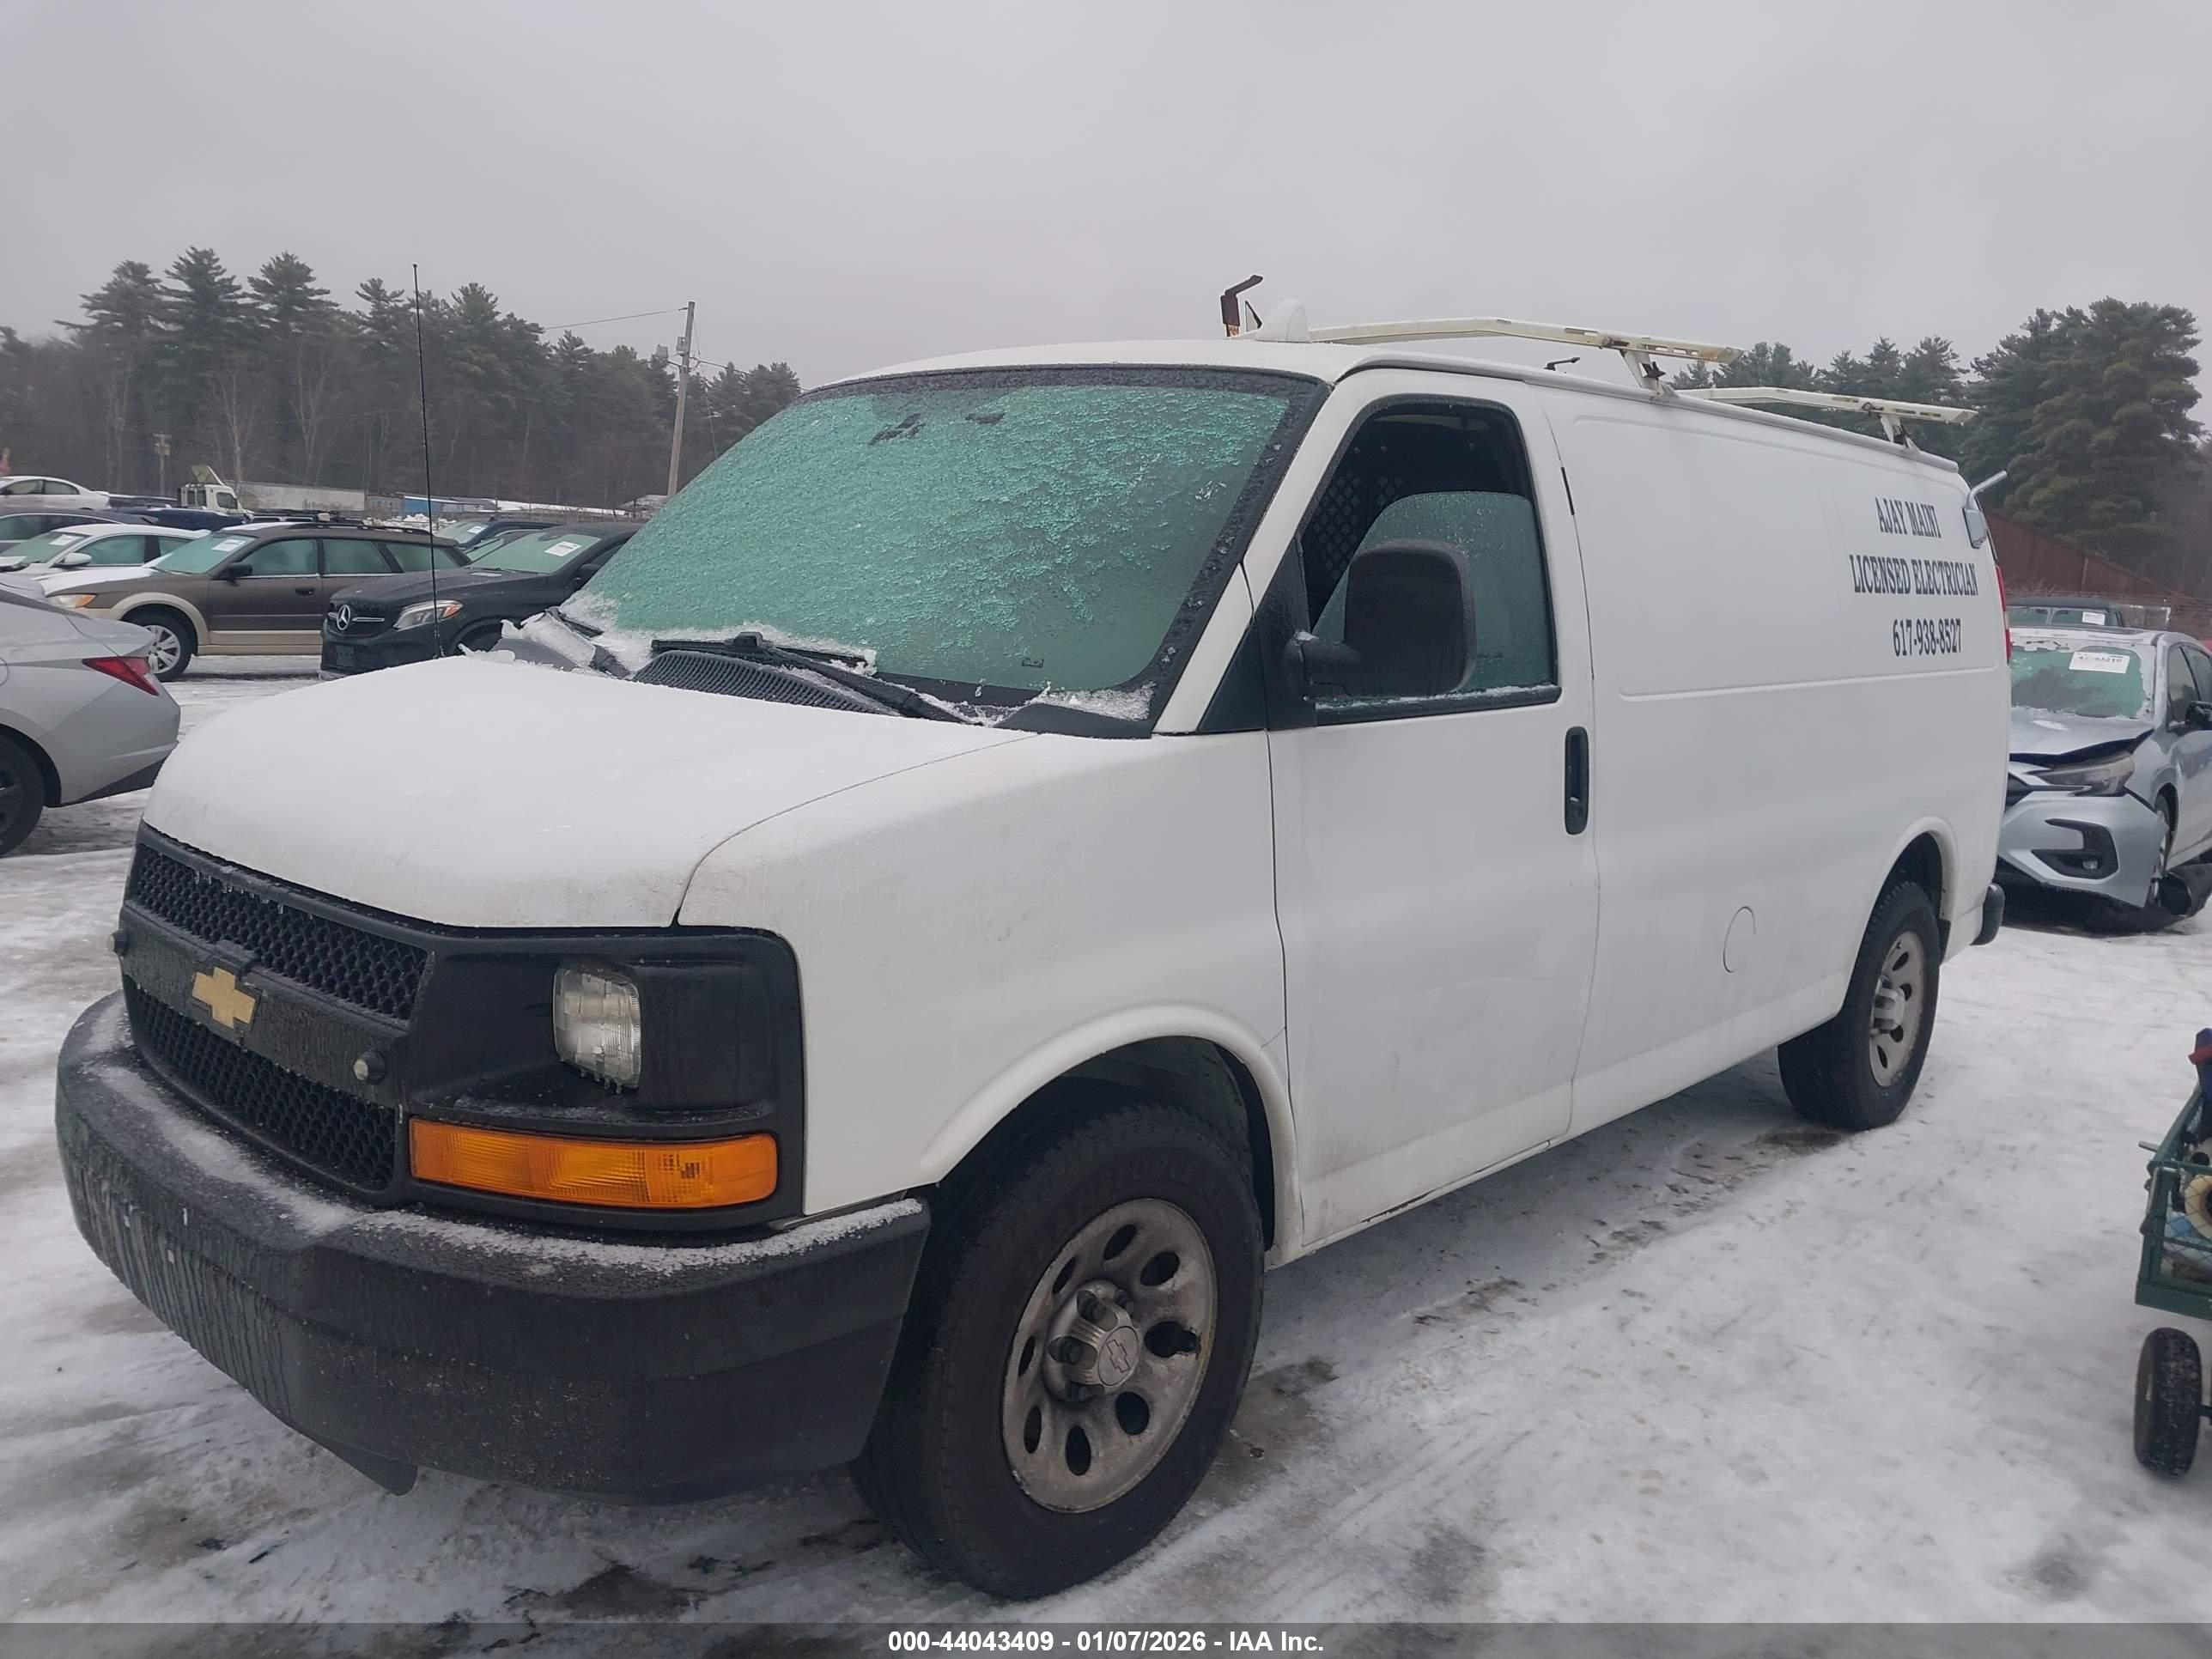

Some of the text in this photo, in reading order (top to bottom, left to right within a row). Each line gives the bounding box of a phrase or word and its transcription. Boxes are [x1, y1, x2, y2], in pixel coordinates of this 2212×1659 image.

[1875, 496, 1908, 535] AJAY
[1848, 554, 1979, 596] LICENSED ELECTRICIAN
[1892, 617, 1961, 658] 617-938-8527
